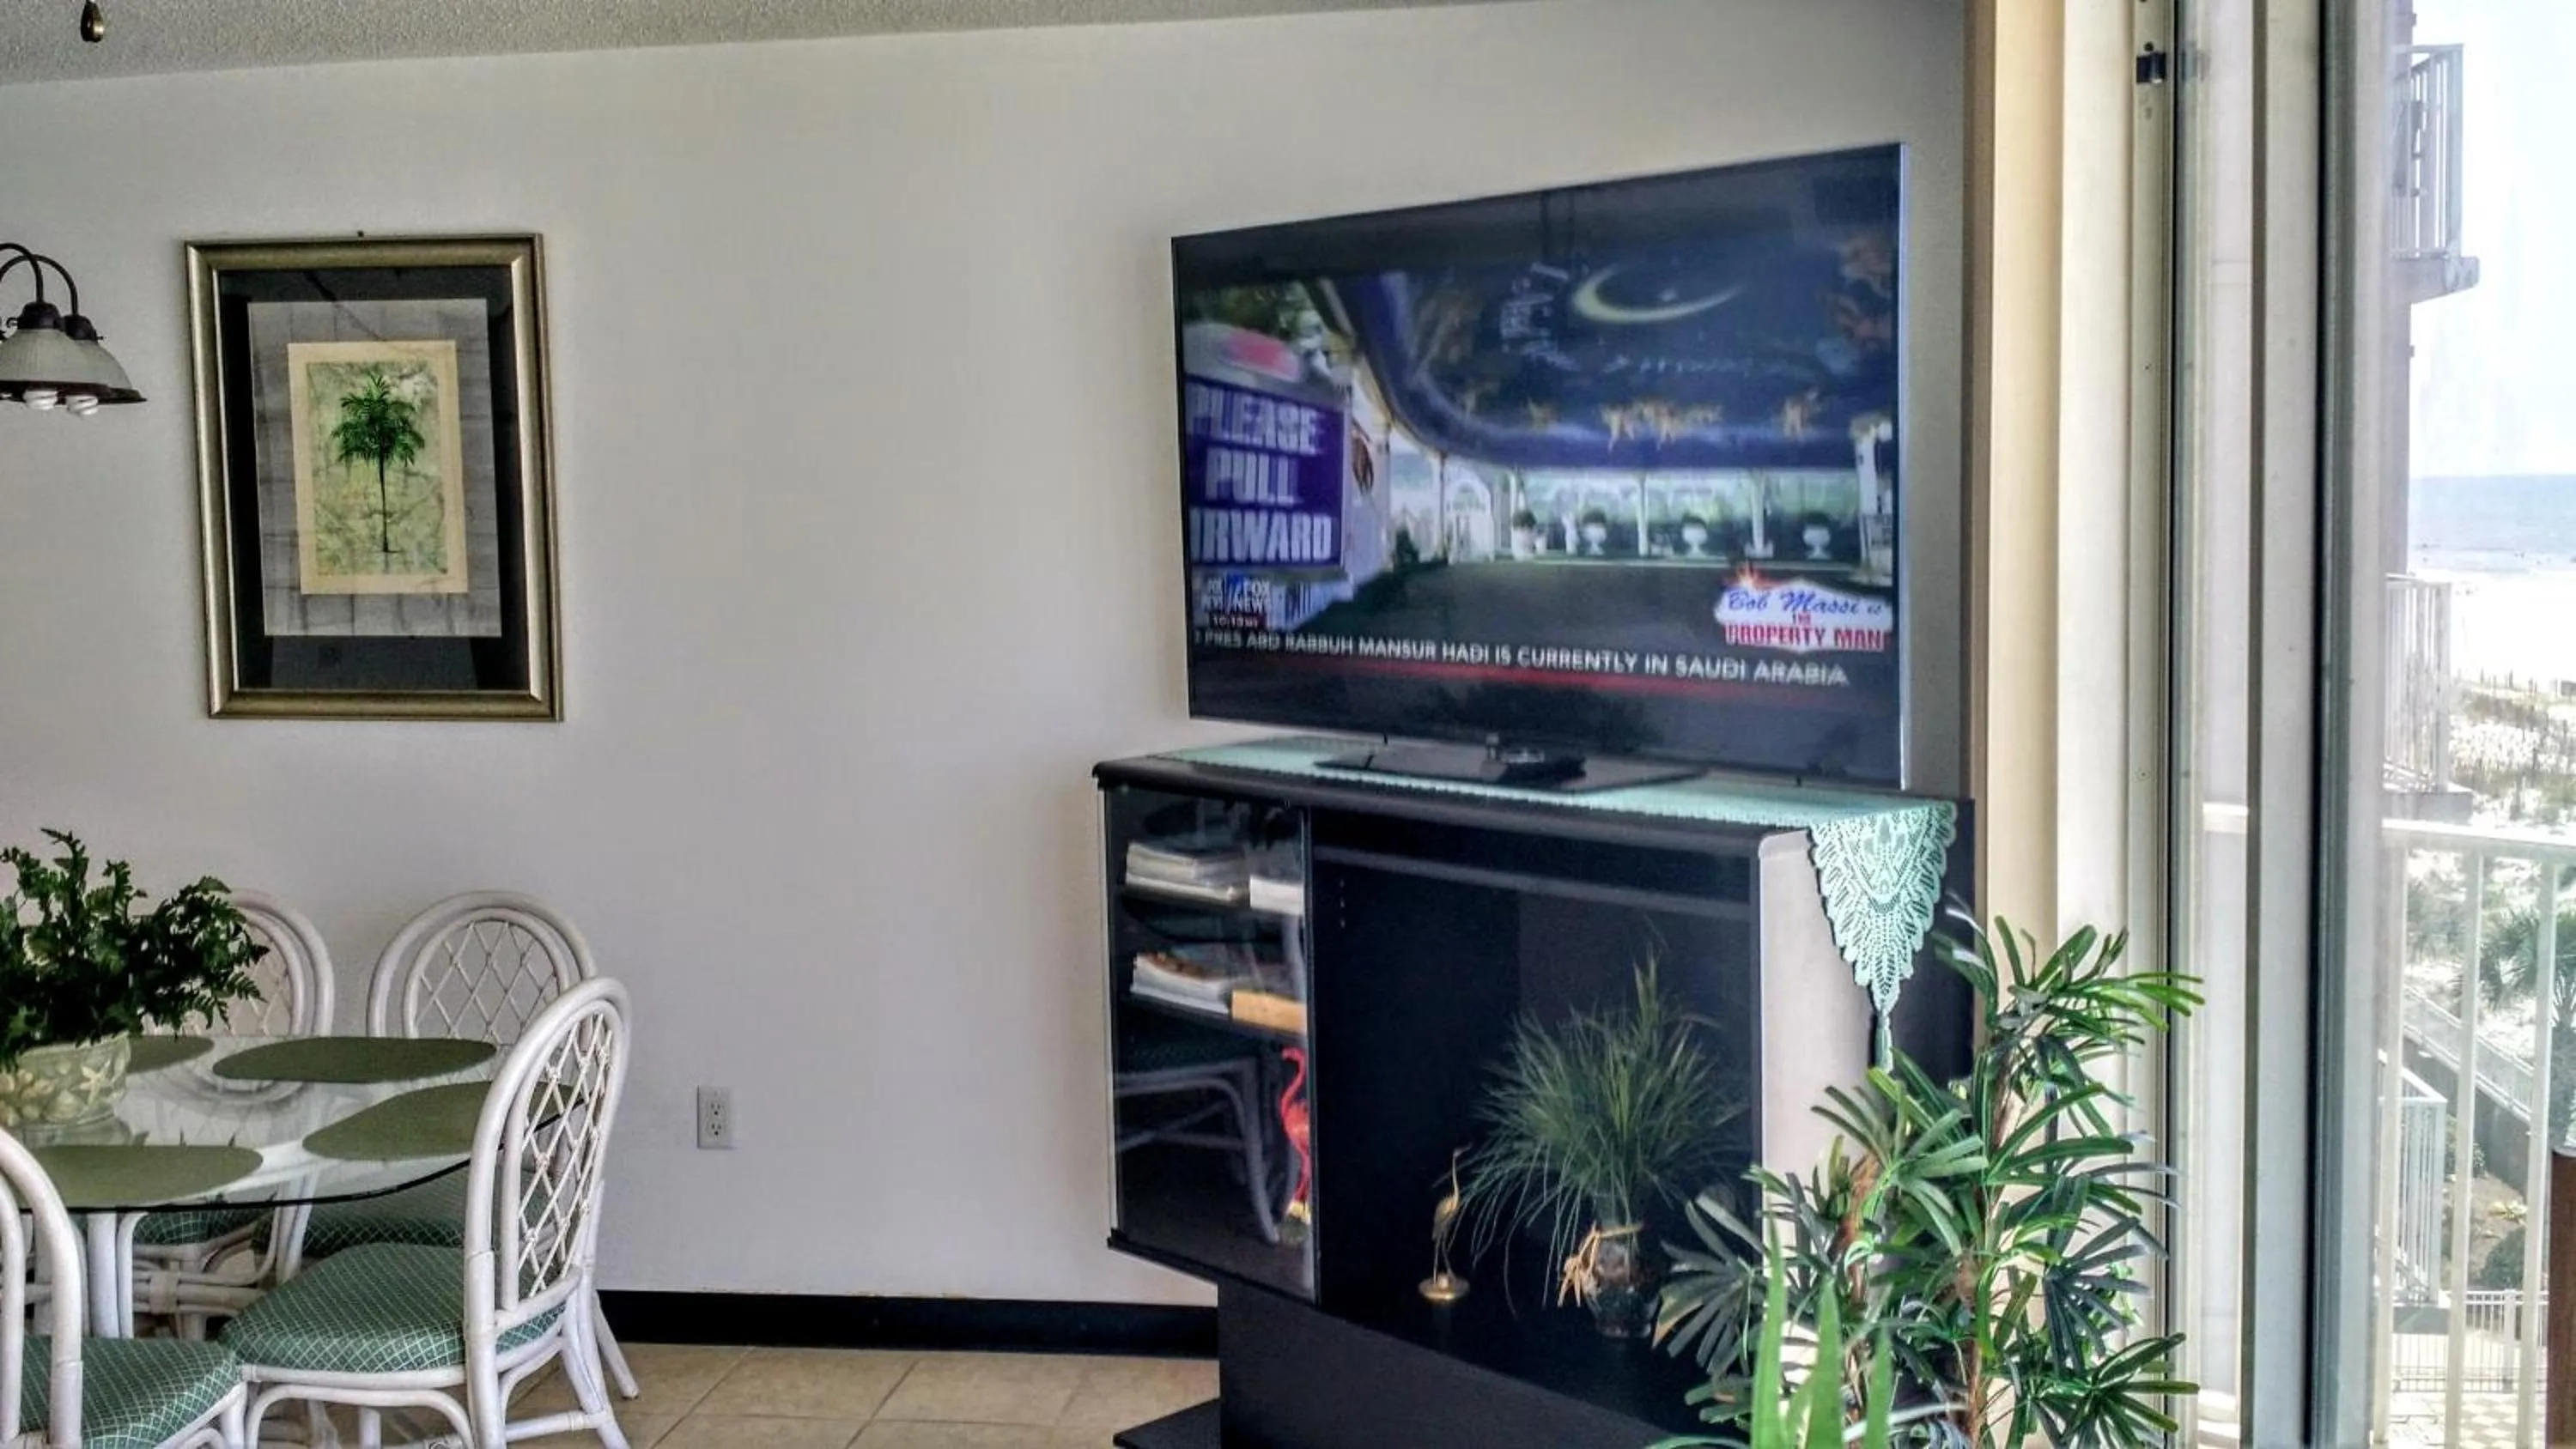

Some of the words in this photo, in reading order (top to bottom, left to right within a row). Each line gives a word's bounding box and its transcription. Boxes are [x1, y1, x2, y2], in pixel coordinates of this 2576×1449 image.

[1206, 446, 1300, 505] PULL
[1728, 589, 1770, 611] Bob
[1780, 590, 1862, 615] Massi
[1724, 621, 1826, 646] PROPERTY
[1834, 627, 1886, 652] MAN
[1358, 636, 1437, 660] MANSUR
[1442, 640, 1489, 664] HADI
[1495, 645, 1511, 665] IS
[1517, 646, 1637, 674] CURRENTLY
[1644, 652, 1668, 676] IN
[1675, 654, 1746, 681] SAUDI
[1753, 658, 1850, 686] ARABIA
